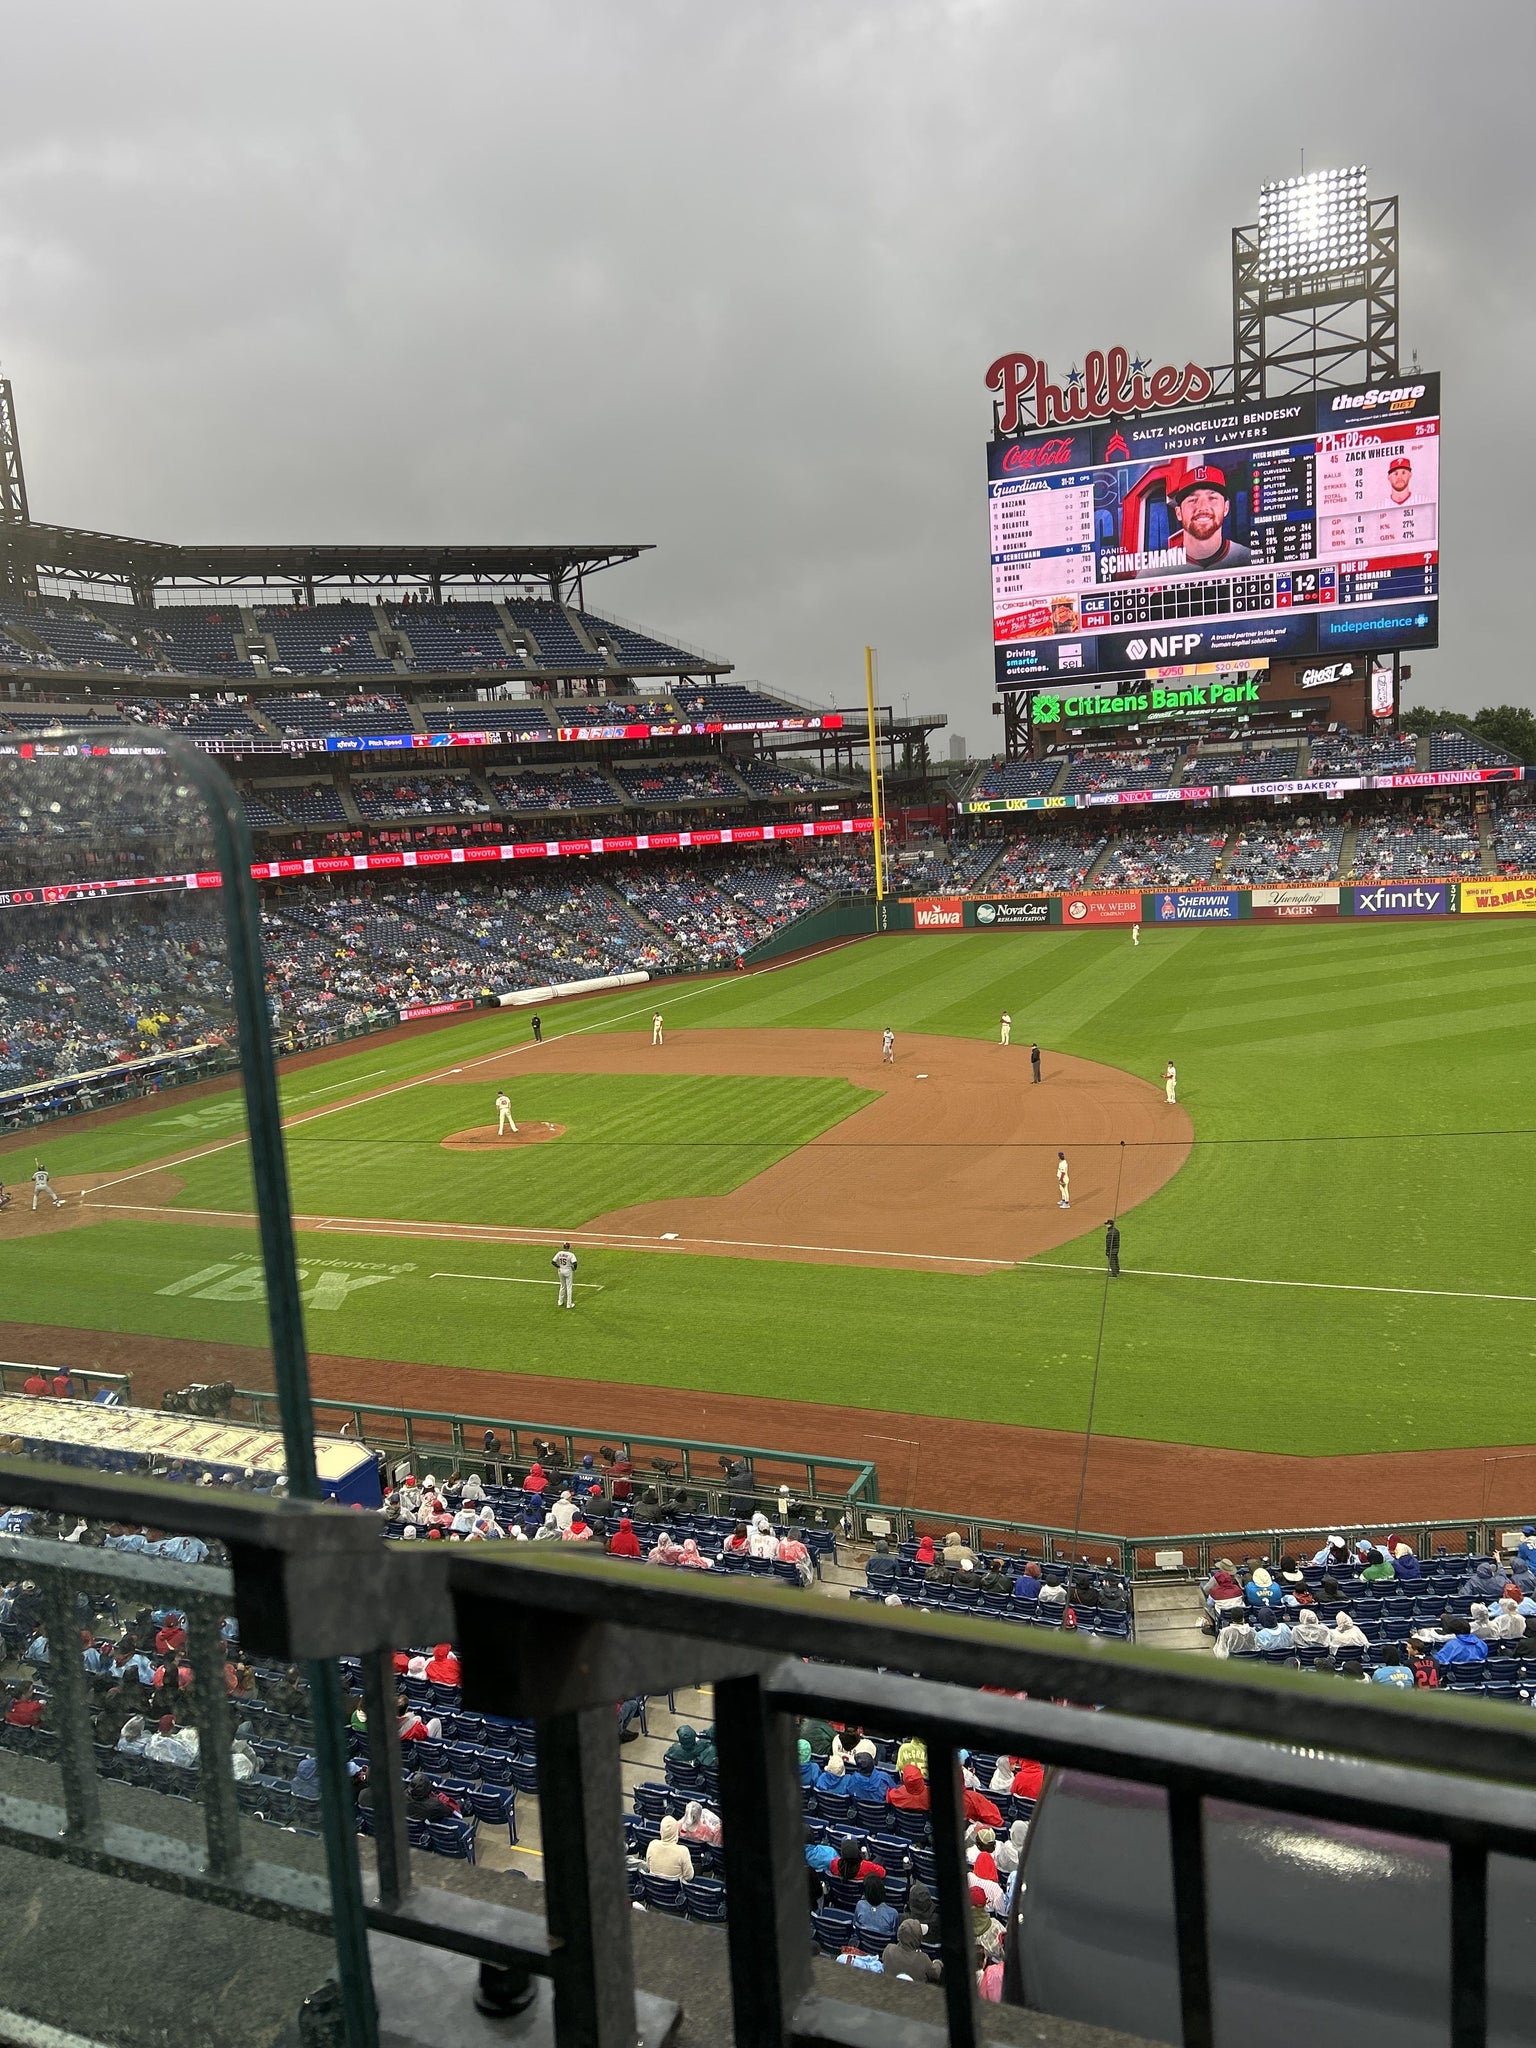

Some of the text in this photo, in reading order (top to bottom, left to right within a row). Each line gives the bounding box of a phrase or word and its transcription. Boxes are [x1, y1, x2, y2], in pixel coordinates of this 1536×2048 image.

[985, 347, 1212, 432] Phillies
[1332, 385, 1425, 411] theScore
[1132, 406, 1301, 441] SALTZ MONGELUZZI BENDESKY
[1164, 428, 1268, 450] INJURY LAWYERS
[1317, 432, 1381, 453] Phillies
[1330, 446, 1404, 464] 45 ZACK WHEELER
[993, 480, 1052, 498] Guardians
[1355, 480, 1363, 488] 45
[1355, 491, 1363, 500] 73
[1101, 546, 1128, 556] DANIEL
[1100, 547, 1187, 575] SCHNEEMANN
[1341, 560, 1368, 573] DUE UP
[1296, 574, 1315, 591] 1-2
[1085, 600, 1105, 611] CLE
[1087, 616, 1104, 625] PHI
[1330, 617, 1412, 634] Independence
[1150, 634, 1200, 658] NFP
[1006, 649, 1036, 658] Driving
[1006, 658, 1038, 666] smarter
[1006, 665, 1049, 674] outcomes.
[1302, 663, 1344, 688] GHOST
[1064, 680, 1260, 716] Citizens Bank Park
[1395, 771, 1481, 785] RAV4th INNING
[1184, 789, 1211, 798] NECA
[1252, 780, 1338, 794] LISCIO'S BAKERY
[1122, 793, 1148, 801] NECA
[969, 797, 1066, 812] UKG UKG UKG
[467, 850, 496, 858] TOYOTA
[516, 846, 545, 854] TOYOTA
[370, 856, 401, 865] TOYOTA
[419, 853, 449, 862] TOYOTA
[317, 860, 350, 869] TOYOTA
[1178, 896, 1229, 907] SHERWIN
[1268, 891, 1324, 905] Yuengling
[1360, 887, 1440, 912] xfinity
[996, 903, 1047, 916] NovaCare
[1090, 902, 1136, 911] F.W. WEBB
[1177, 907, 1231, 918] WILLIAMS.
[1278, 907, 1313, 916] LAGER
[917, 911, 960, 925] Wawa
[432, 1004, 454, 1013] INNING
[1415, 1669, 1438, 1689] 24
[903, 1750, 926, 1760] McGRA
